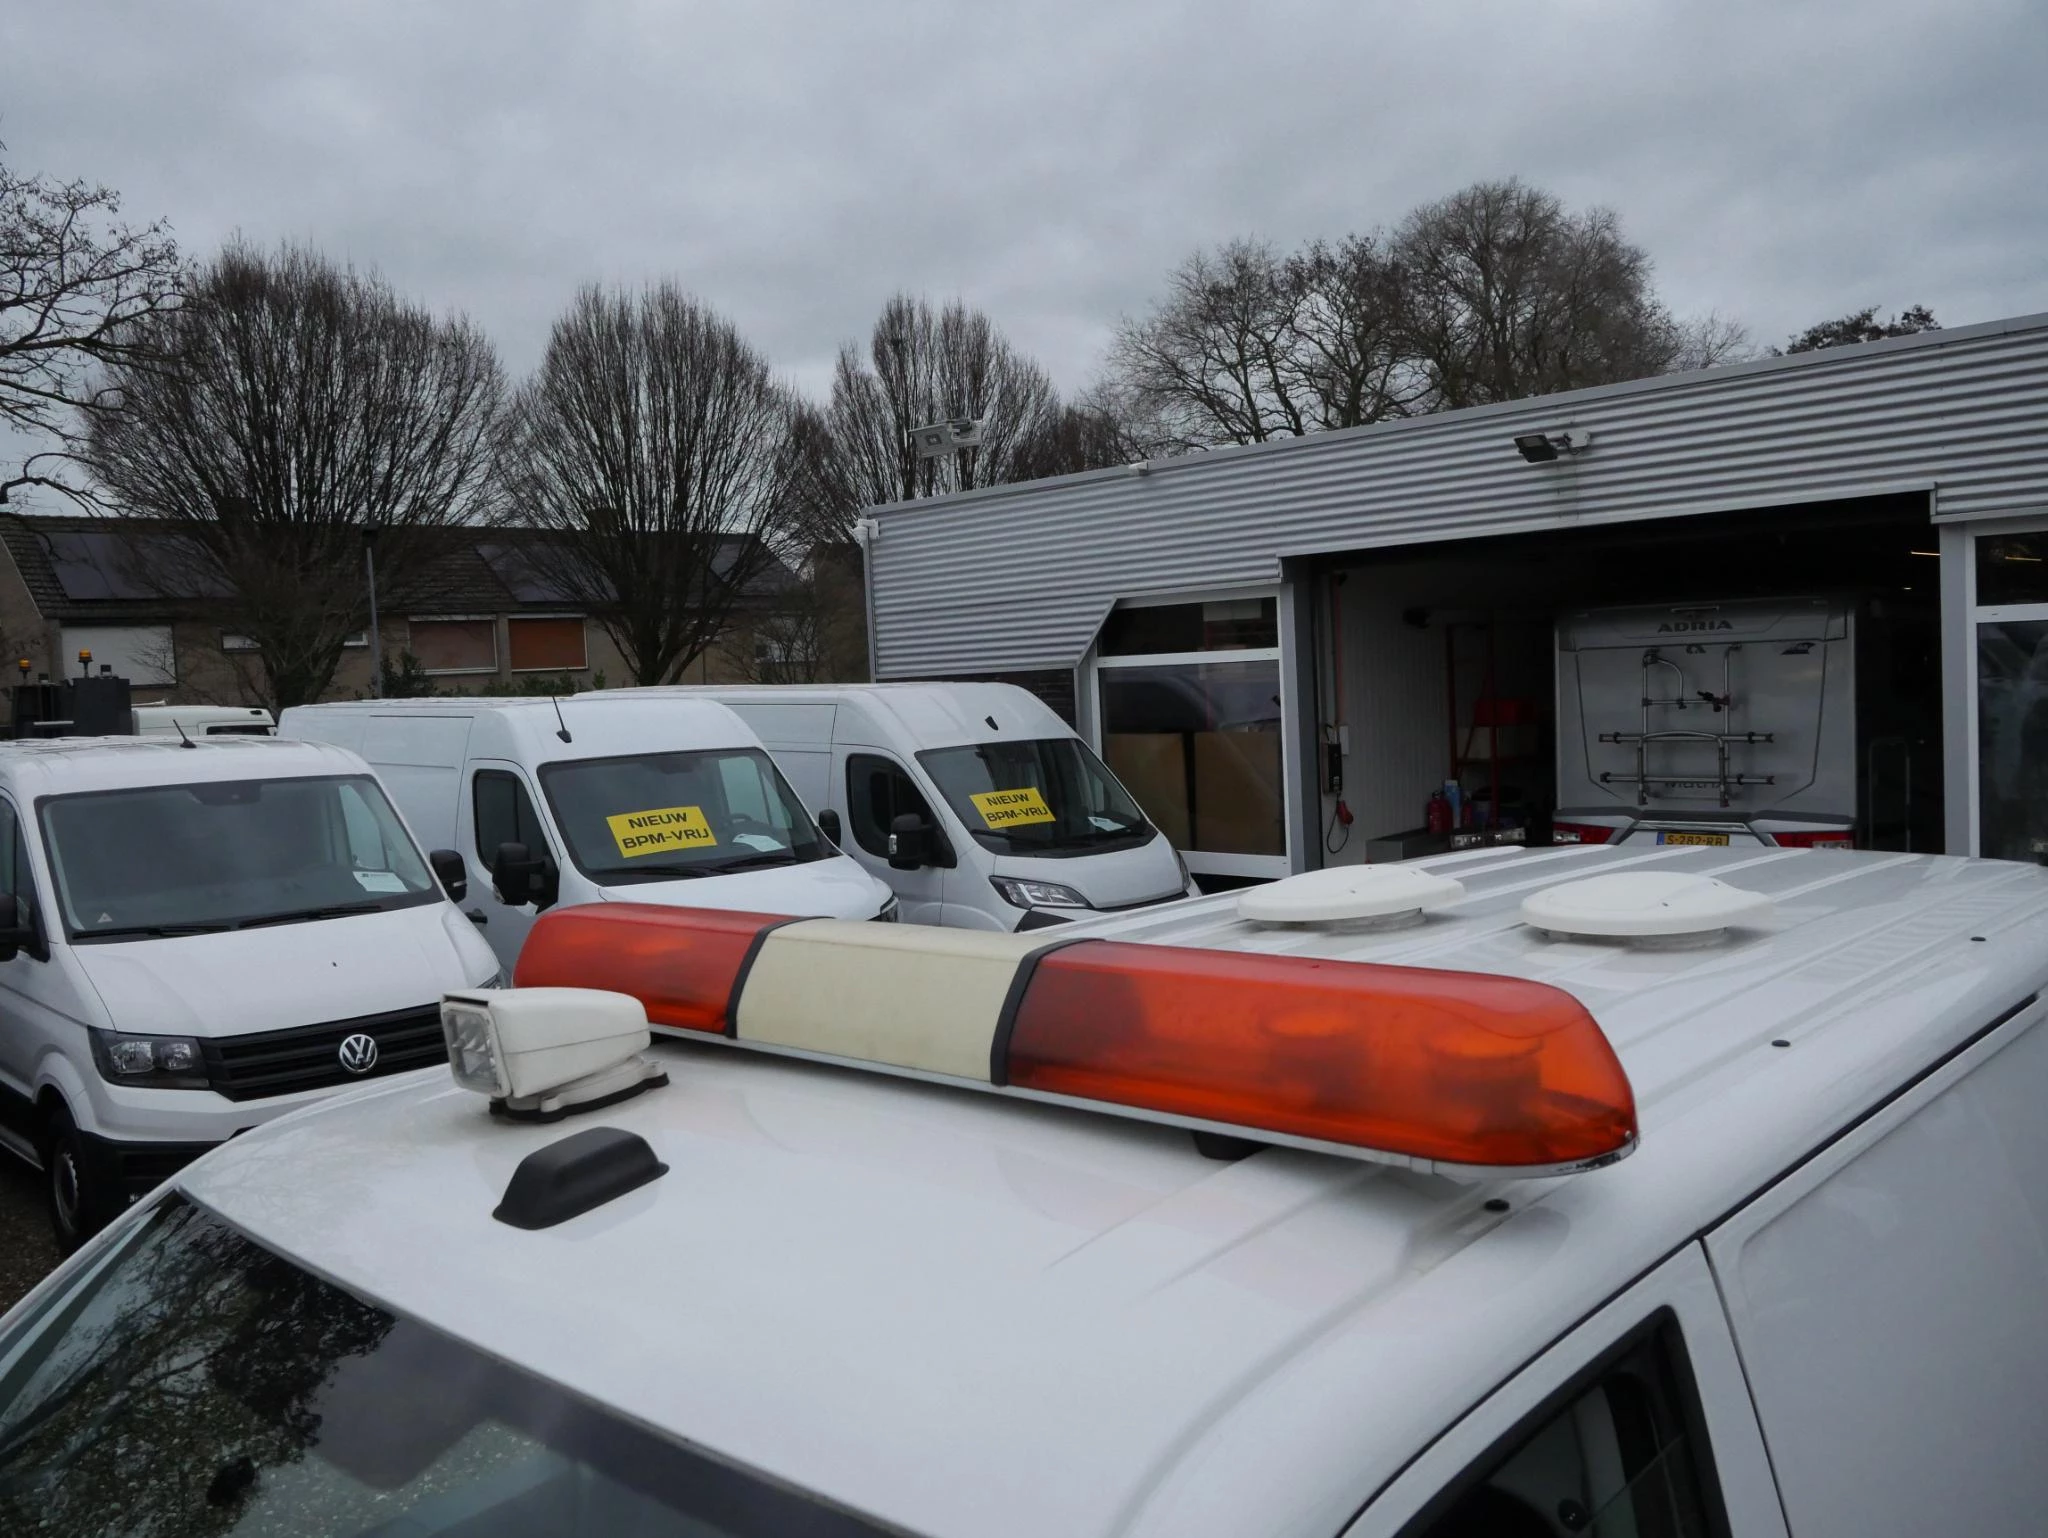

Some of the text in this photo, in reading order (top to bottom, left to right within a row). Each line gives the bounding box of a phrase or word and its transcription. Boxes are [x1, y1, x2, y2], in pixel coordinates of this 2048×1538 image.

[1657, 619, 1733, 633] ADRIA
[985, 793, 1031, 806] NIEUW
[628, 812, 687, 829] NIEUW
[985, 806, 1049, 822] BPM-VRIJ
[622, 828, 709, 849] BPM-VRIJ
